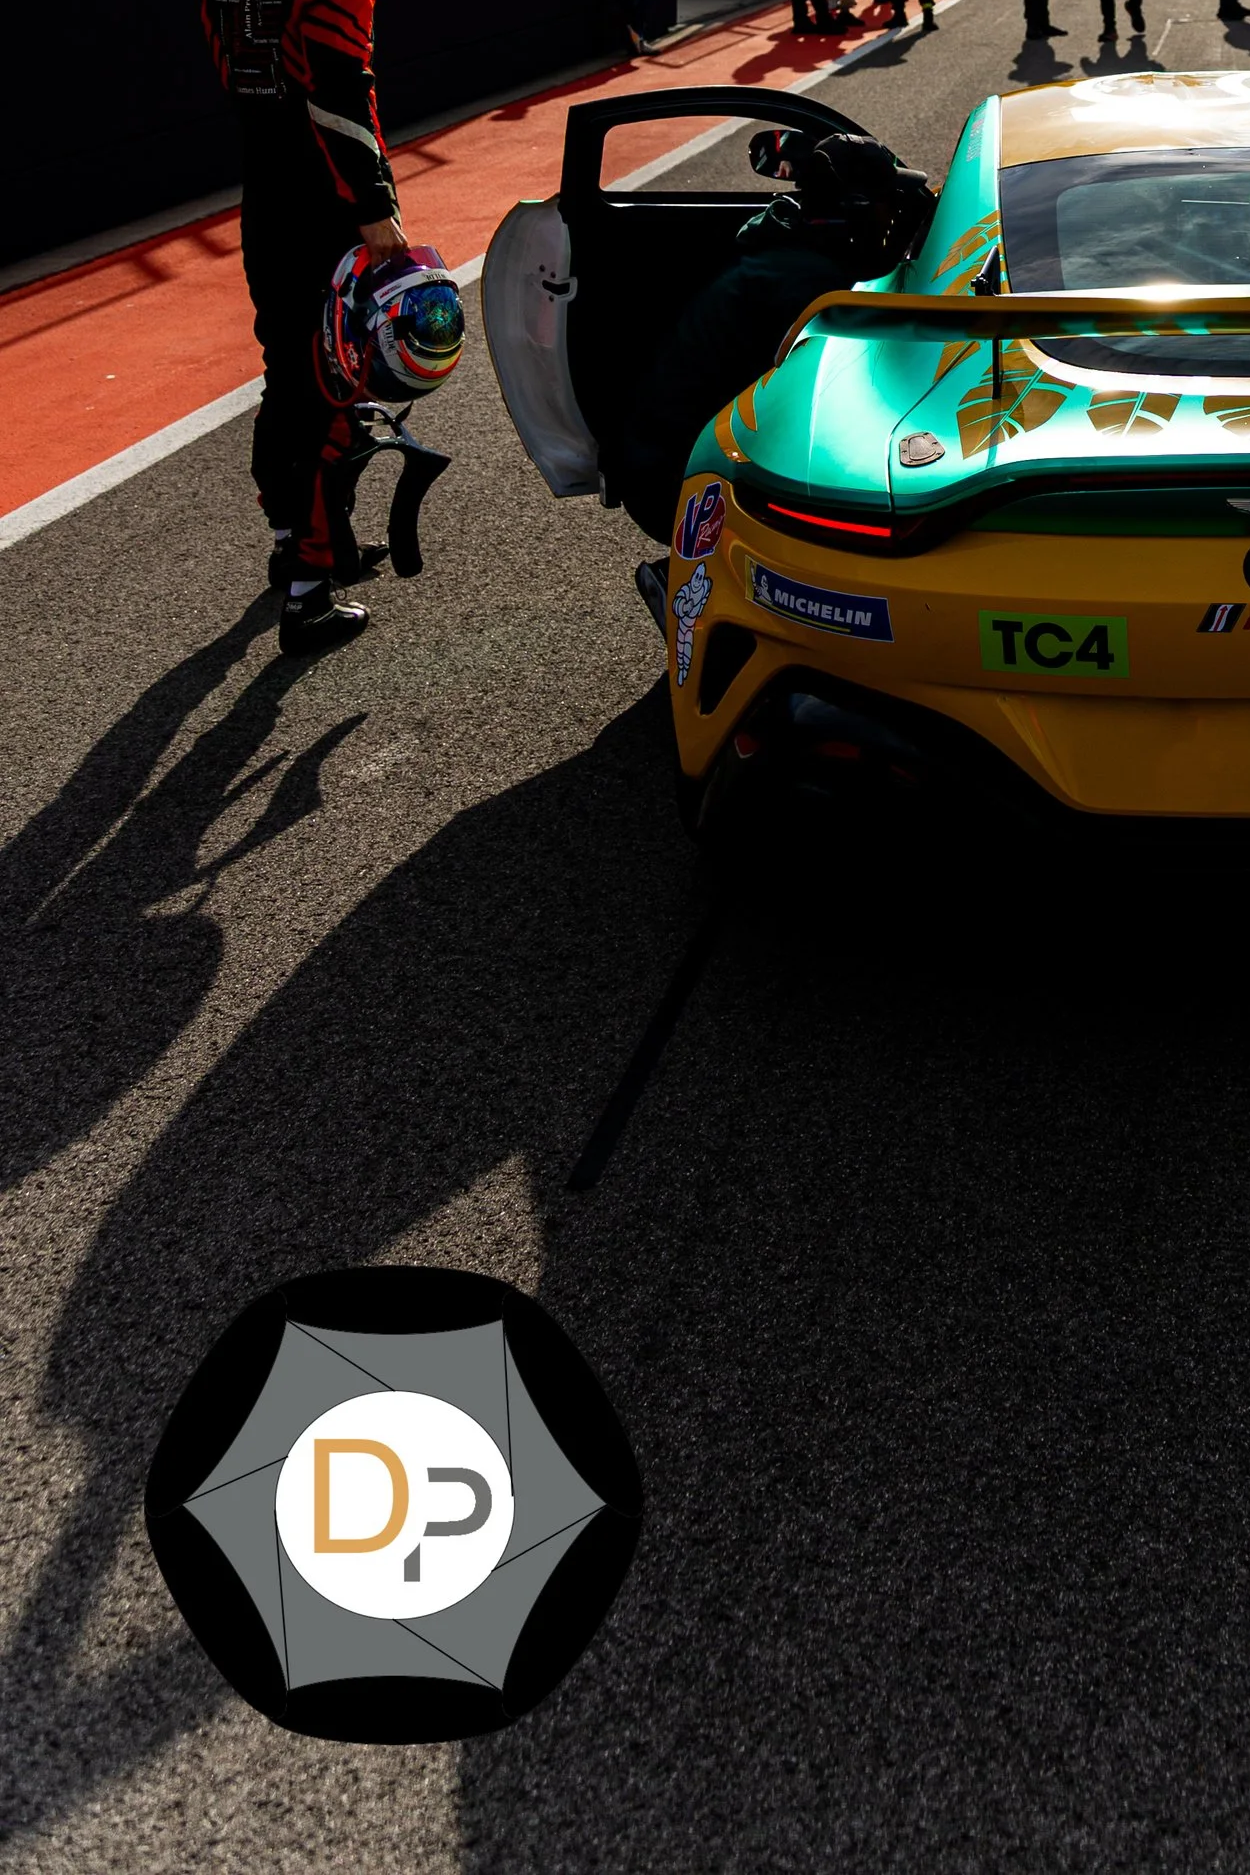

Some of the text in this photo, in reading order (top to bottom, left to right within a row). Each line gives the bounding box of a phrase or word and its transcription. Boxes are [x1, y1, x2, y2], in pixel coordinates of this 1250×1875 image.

[244, 15, 253, 39] Alain
[255, 86, 277, 95] Hunt
[682, 482, 722, 559] VP
[773, 588, 873, 627] MICHELIN
[992, 620, 1115, 671] TC4
